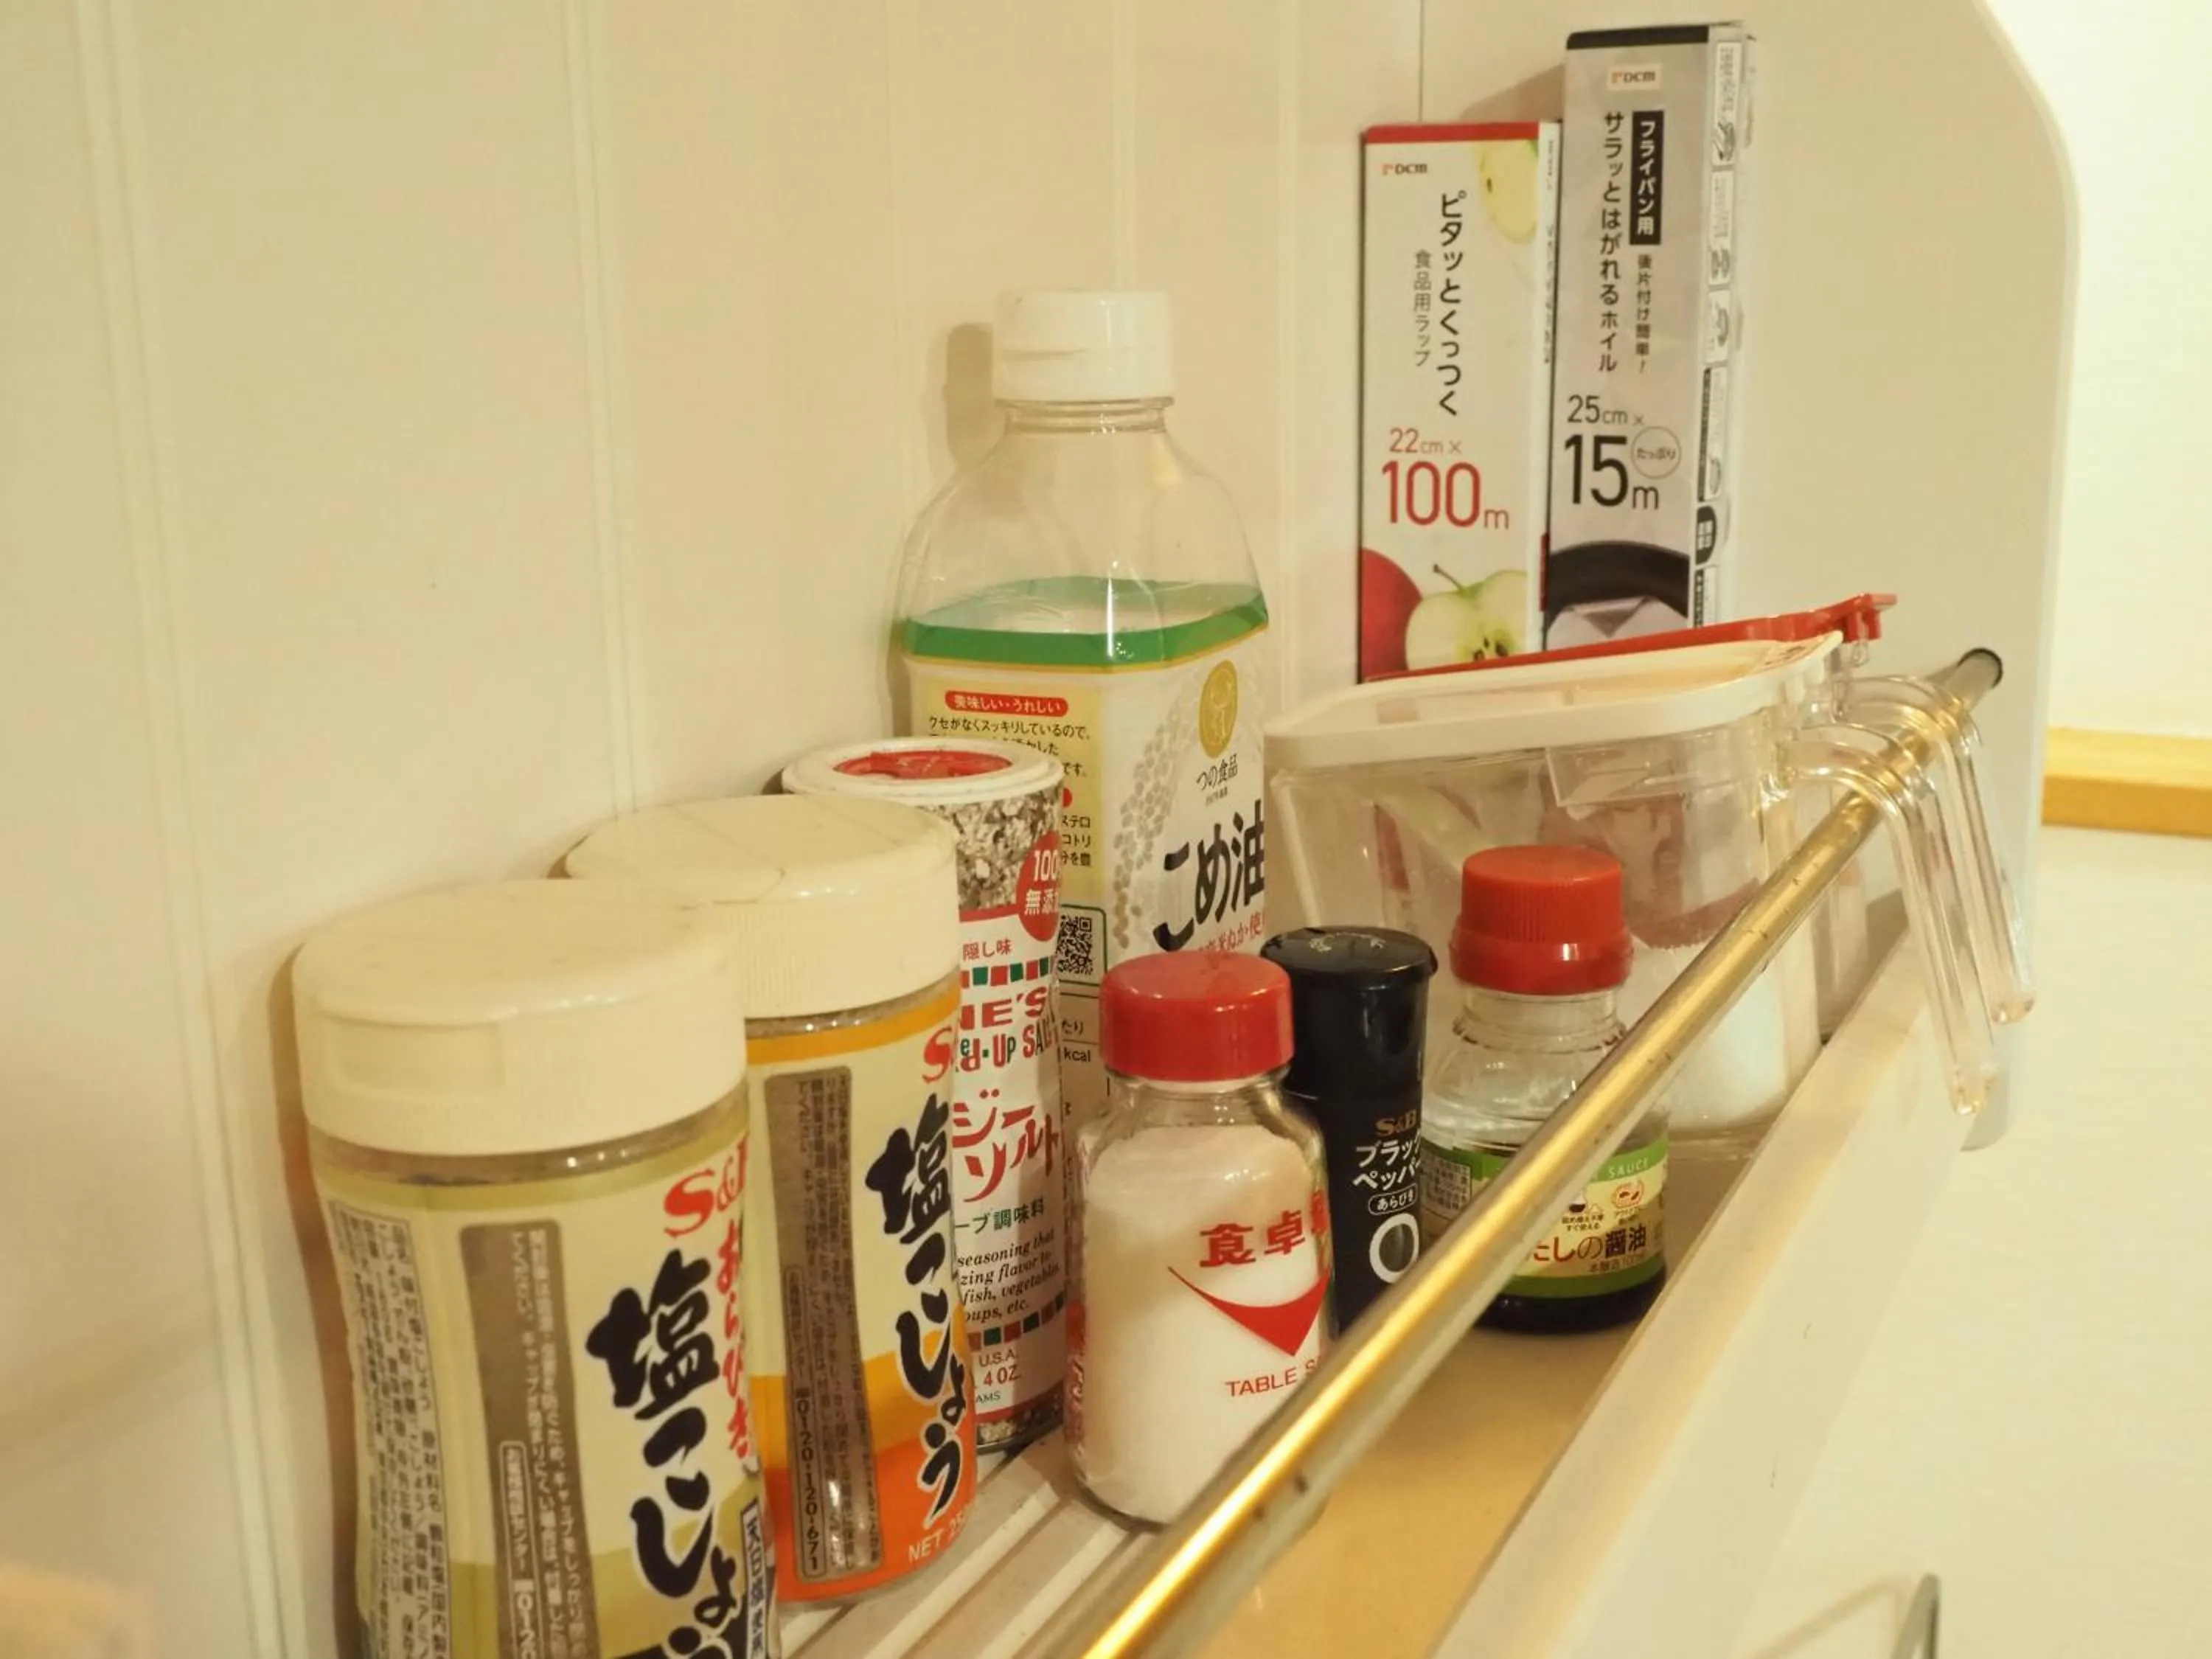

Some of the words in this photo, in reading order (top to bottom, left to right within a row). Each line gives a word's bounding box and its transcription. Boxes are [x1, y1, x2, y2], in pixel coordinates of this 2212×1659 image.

[1636, 121, 1656, 236] フライパン用
[1599, 111, 1624, 372] サラッとはがれるホイル
[1413, 249, 1433, 366] 食品用ラップ
[1436, 190, 1467, 417] ピタッとくっつく
[1636, 448, 1676, 461] たっぷり
[1062, 834, 1091, 848] コトリ
[1152, 799, 1265, 952] こめ油
[1063, 1048, 1091, 1062] kcal
[958, 1241, 1031, 1267] seasoning
[1225, 1366, 1298, 1397] TABLE
[908, 1527, 945, 1565] NET
